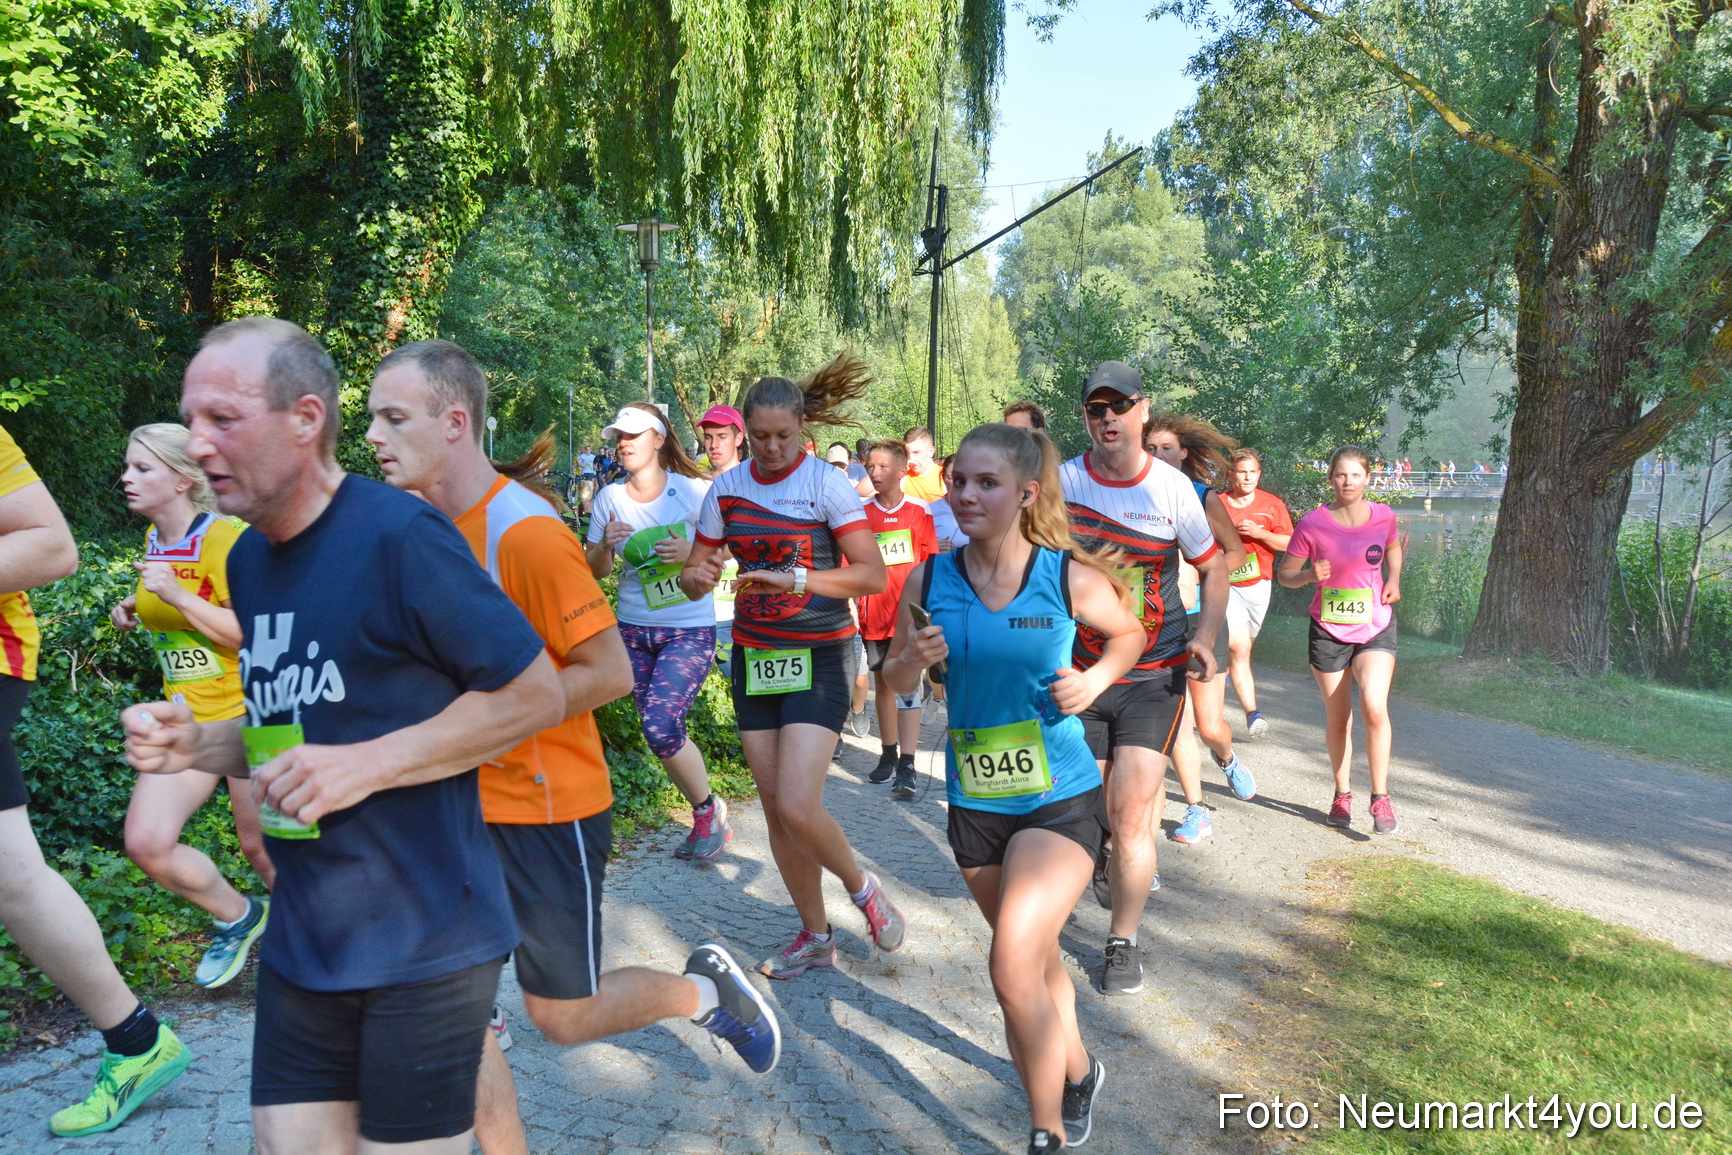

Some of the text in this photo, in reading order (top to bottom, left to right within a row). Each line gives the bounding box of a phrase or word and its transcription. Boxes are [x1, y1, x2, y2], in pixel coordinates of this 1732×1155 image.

[1123, 512, 1167, 524] NEUMARKT
[1327, 600, 1365, 614] 1443
[1008, 617, 1053, 629] THULE
[163, 649, 208, 670] 1259
[753, 657, 803, 679] 1875
[965, 748, 1034, 778] 1946
[974, 776, 1030, 788] Burghardt Alina
